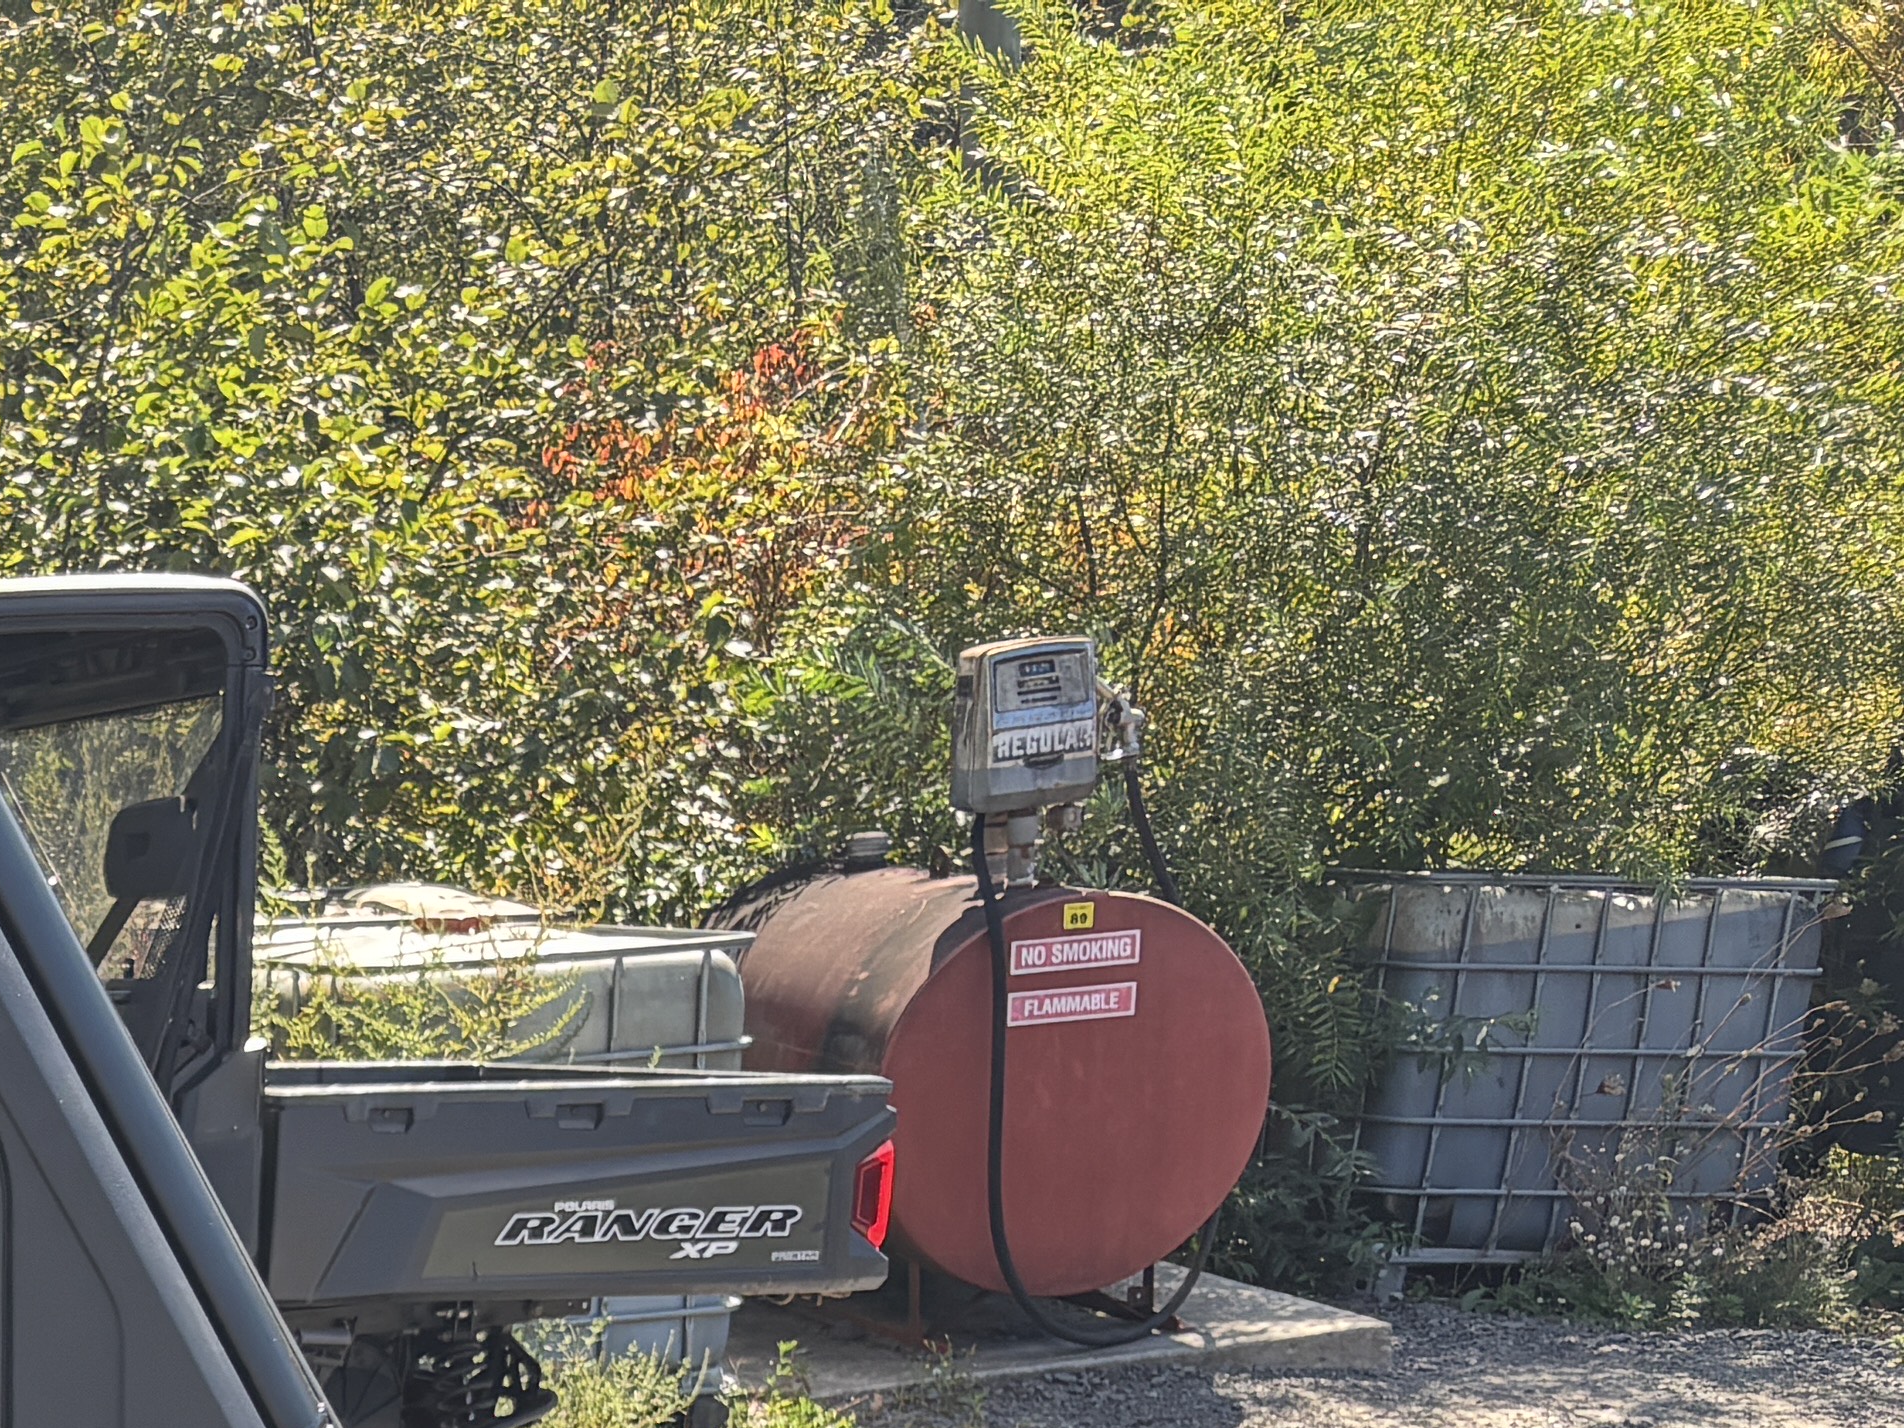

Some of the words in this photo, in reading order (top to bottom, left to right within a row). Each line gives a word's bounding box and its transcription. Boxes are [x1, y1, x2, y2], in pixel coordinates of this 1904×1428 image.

[1021, 945, 1046, 967] NO
[1051, 937, 1132, 964] SMOKING
[1023, 991, 1120, 1018] FLAMMABLE
[494, 1205, 802, 1246] RANGER
[669, 1241, 738, 1260] XP
